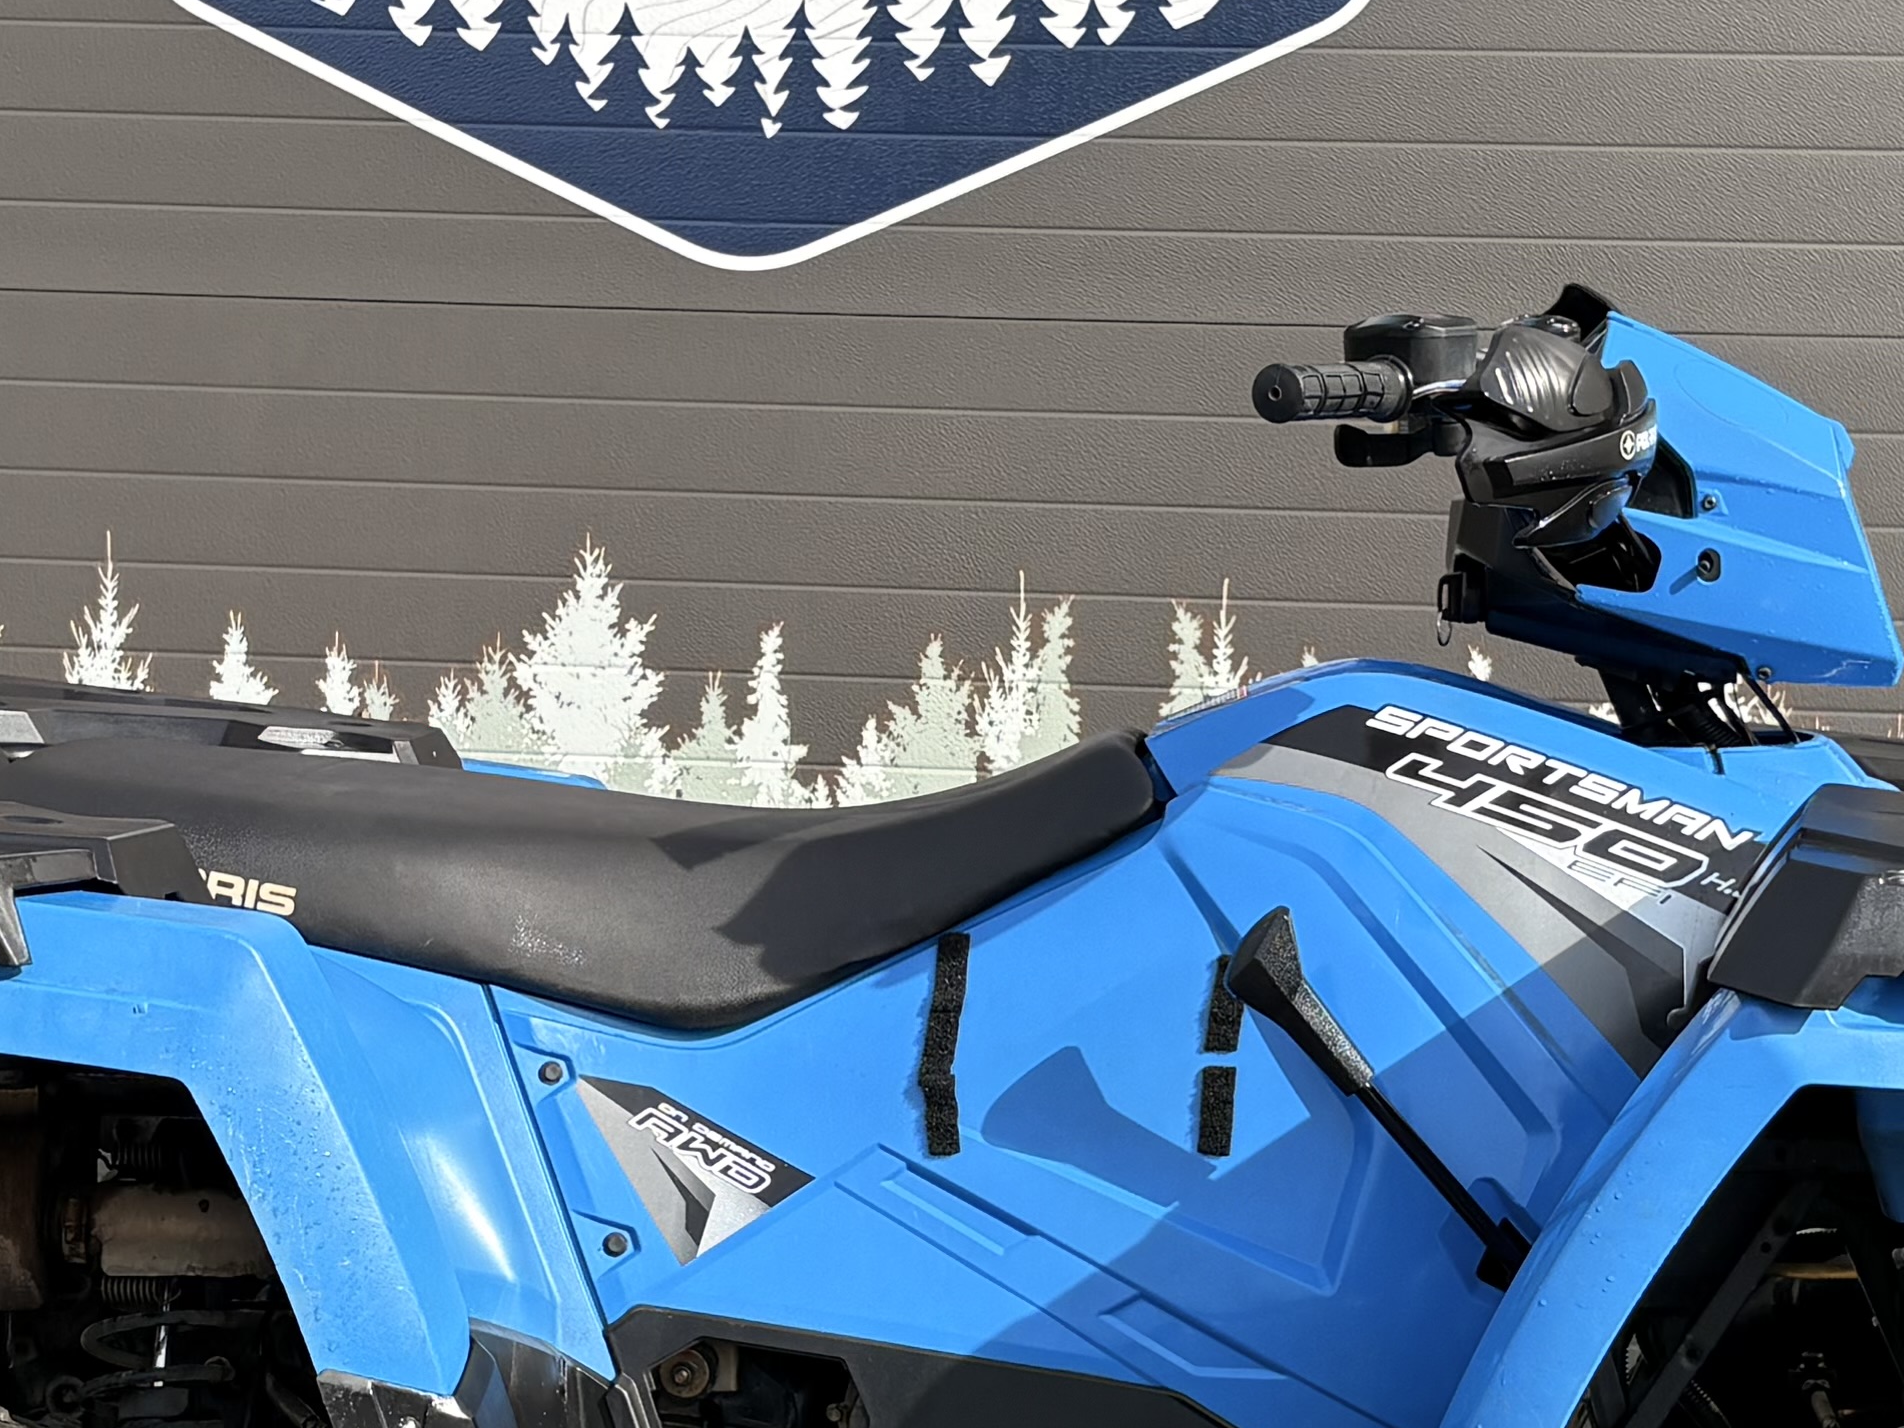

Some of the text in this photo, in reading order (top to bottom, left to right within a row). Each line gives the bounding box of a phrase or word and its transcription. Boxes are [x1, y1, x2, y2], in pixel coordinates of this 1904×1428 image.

[1365, 704, 1754, 851] SPORTSMAN
[1385, 751, 1710, 888] 450
[198, 868, 297, 916] RIS
[1567, 859, 1673, 905] EFI
[628, 1107, 772, 1193] AWD
